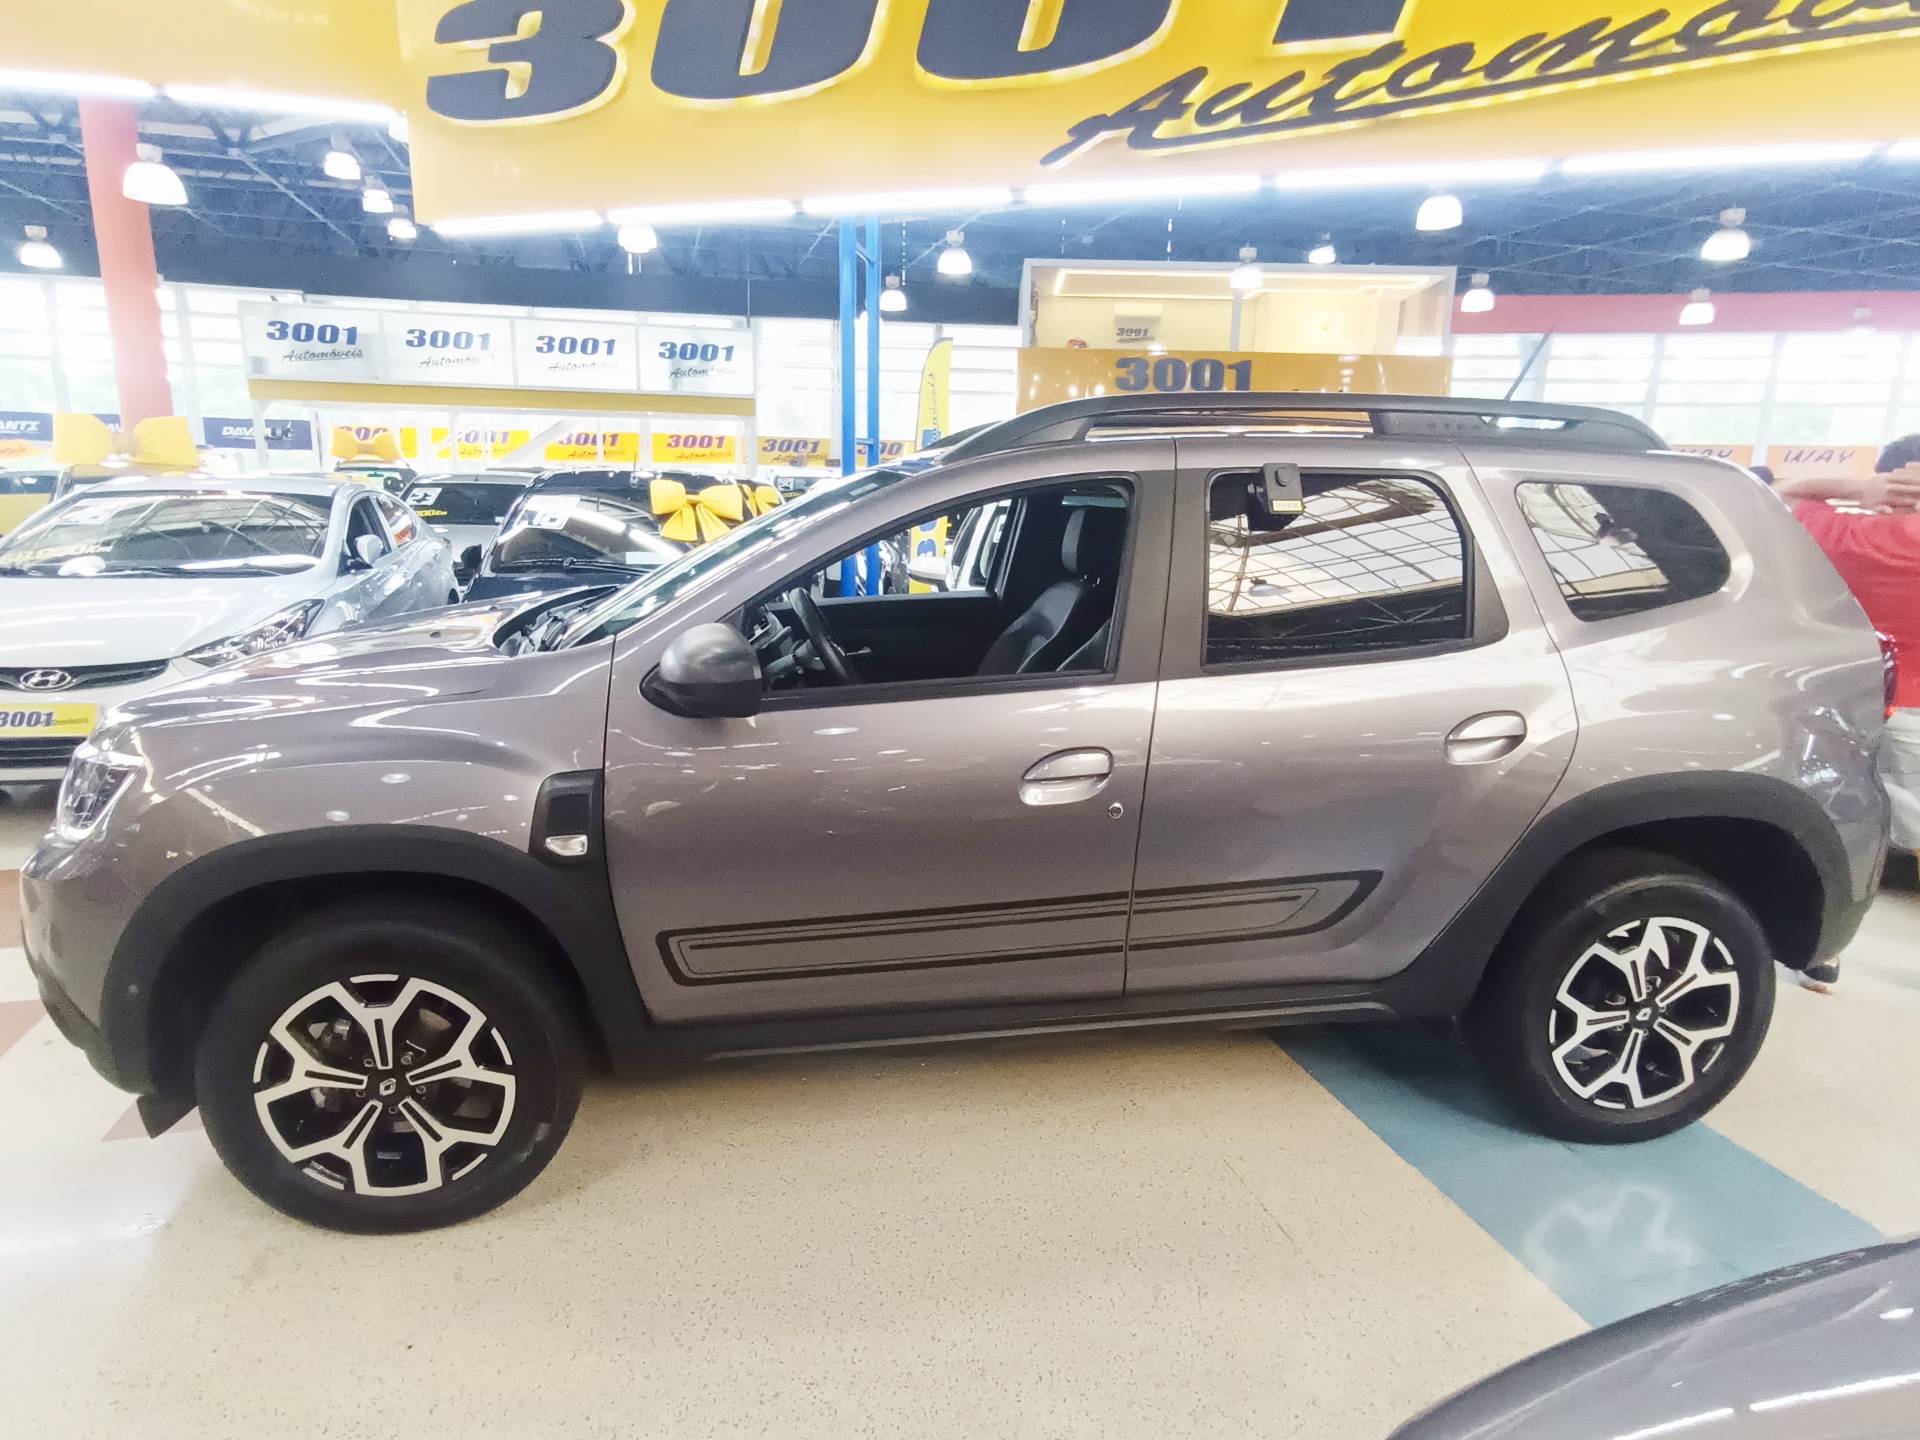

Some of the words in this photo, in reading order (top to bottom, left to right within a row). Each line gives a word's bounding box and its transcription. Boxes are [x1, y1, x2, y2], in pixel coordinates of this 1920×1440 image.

[267, 320, 357, 345] 3001
[405, 328, 491, 350] 3001
[535, 335, 616, 356] 3001
[658, 341, 735, 362] 3001
[1115, 357, 1252, 391] 3001
[666, 434, 726, 448] 3001
[1783, 449, 1856, 463] WAY
[0, 711, 54, 728] 3001
